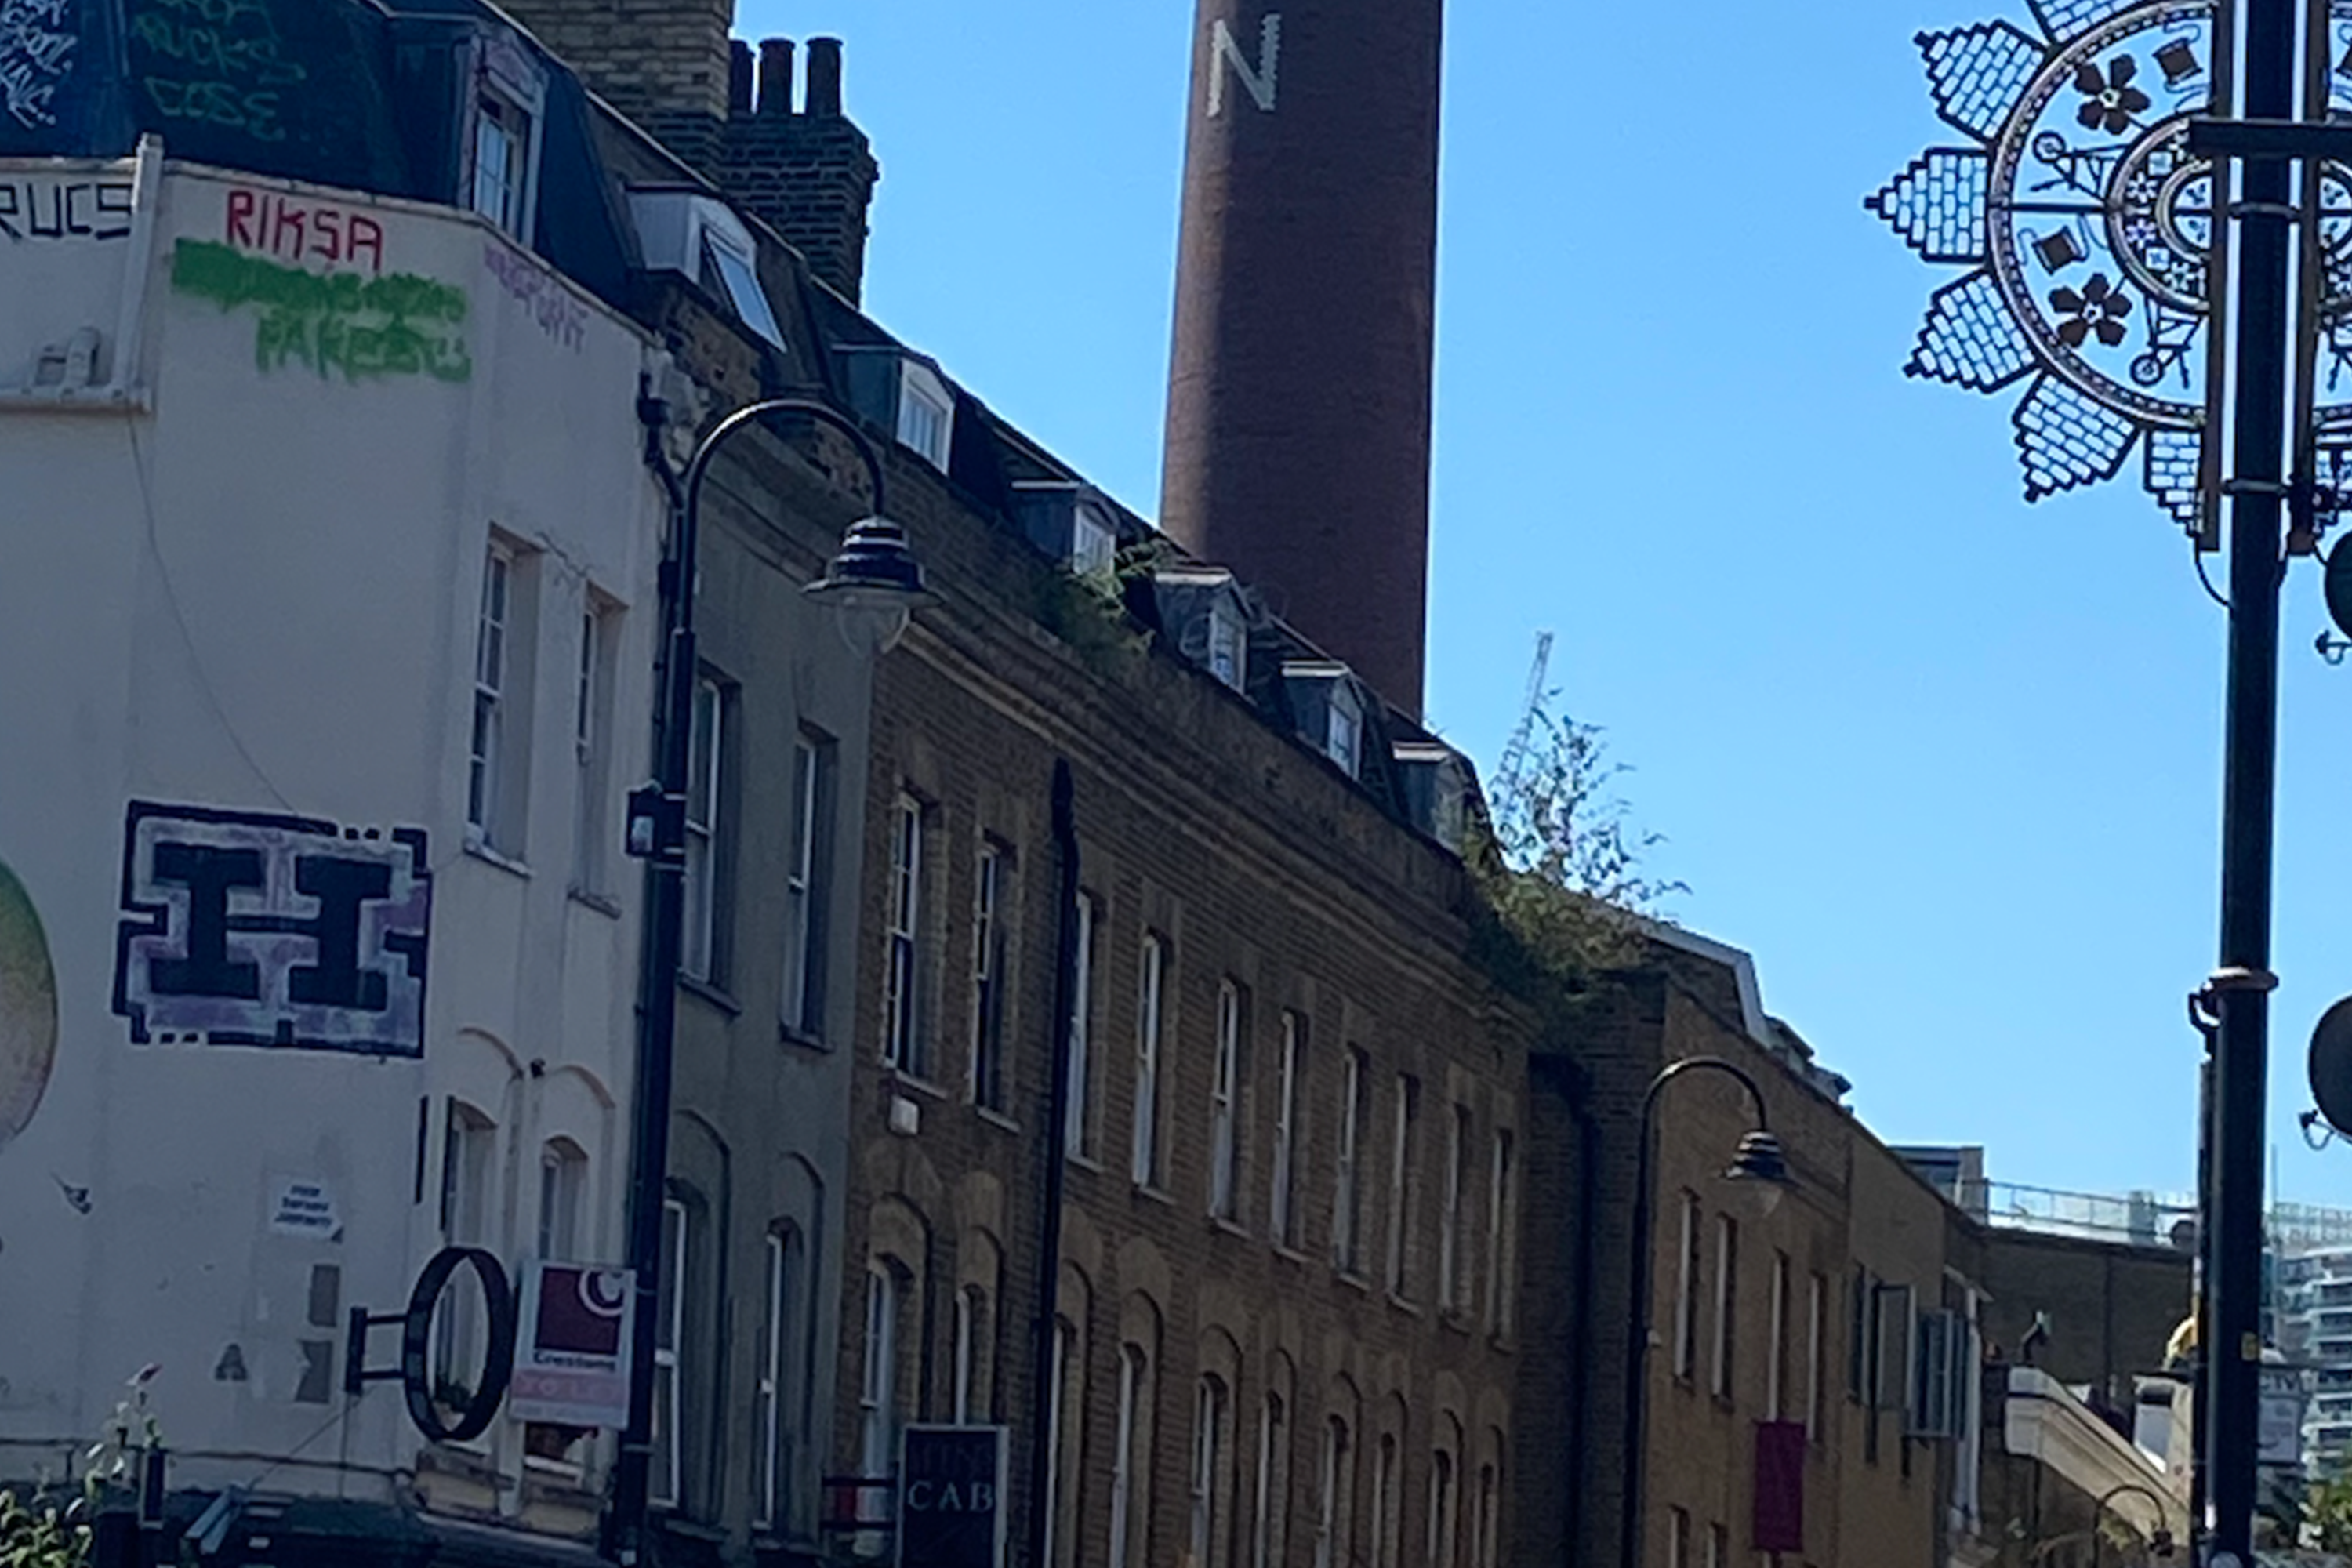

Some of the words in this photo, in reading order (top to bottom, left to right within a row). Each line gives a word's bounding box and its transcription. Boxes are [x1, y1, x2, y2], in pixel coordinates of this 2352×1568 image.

[1206, 13, 1282, 118] N
[227, 189, 383, 271] RIKSA
[908, 1480, 994, 1513] CAB
